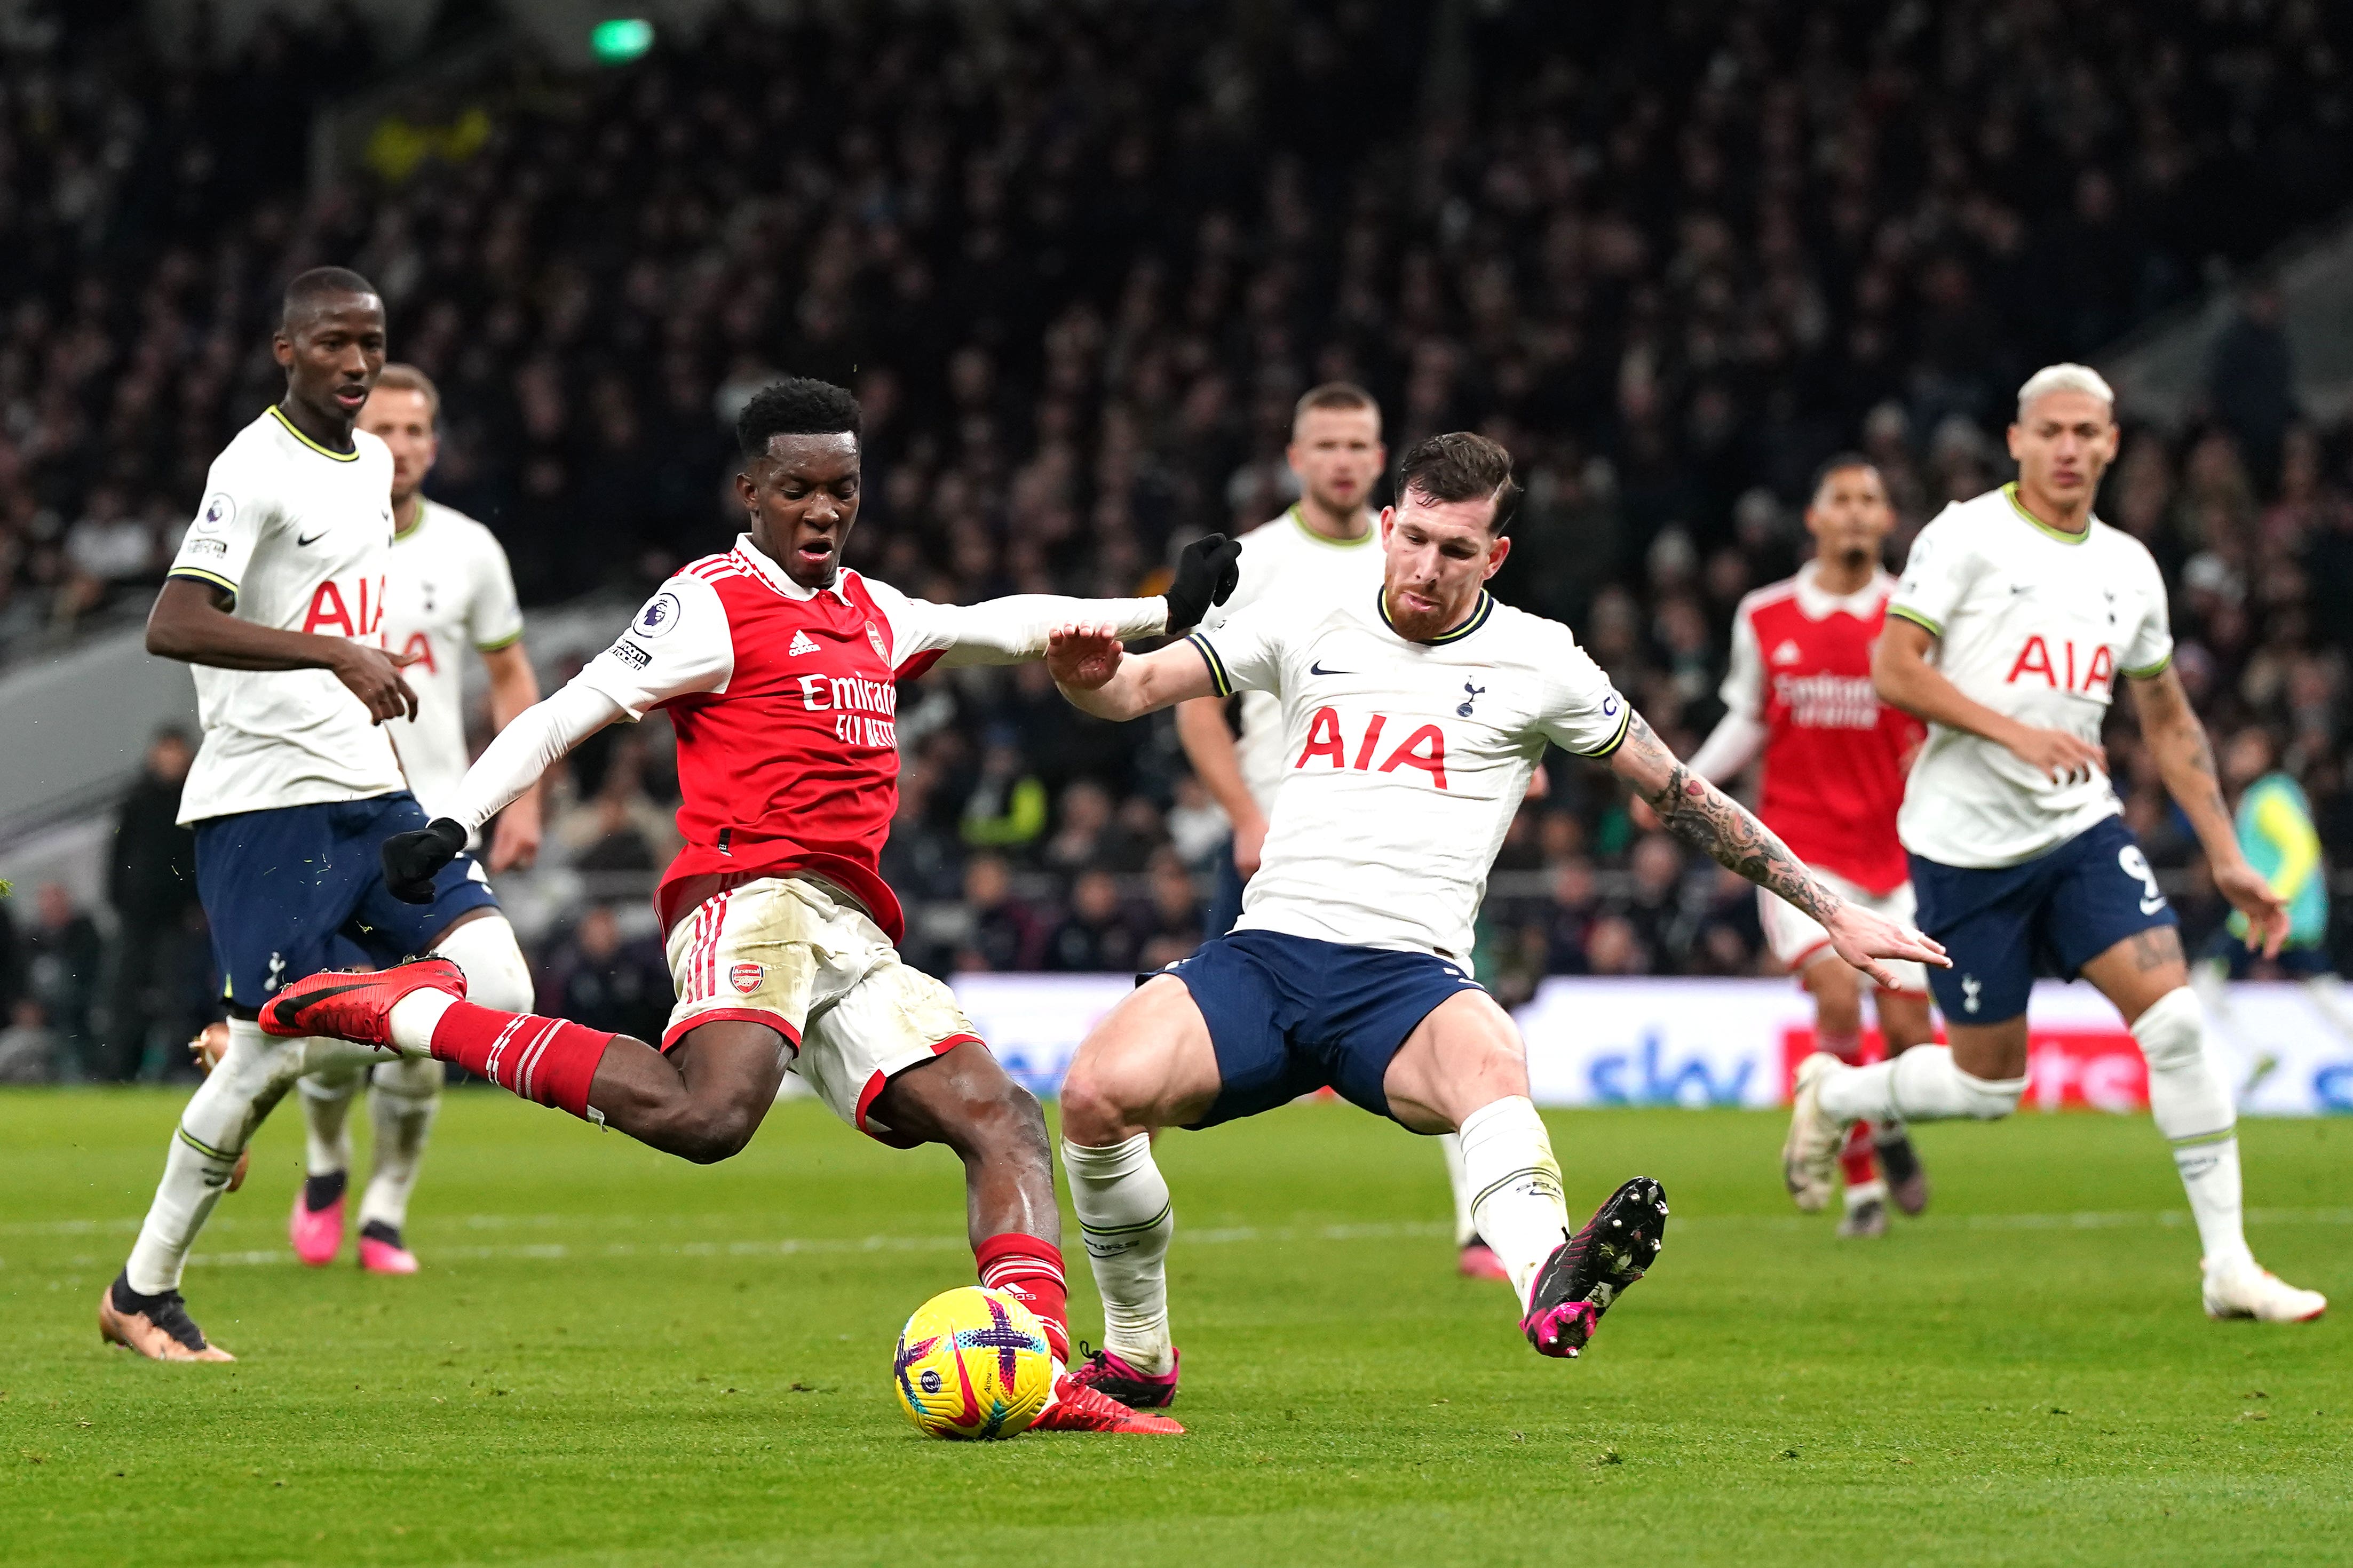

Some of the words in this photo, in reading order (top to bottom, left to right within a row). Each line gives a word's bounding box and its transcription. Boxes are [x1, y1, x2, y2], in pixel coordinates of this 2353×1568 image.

[789, 644, 821, 657] adidas
[2006, 636, 2112, 694] AIA
[1294, 707, 1447, 790] AIA
